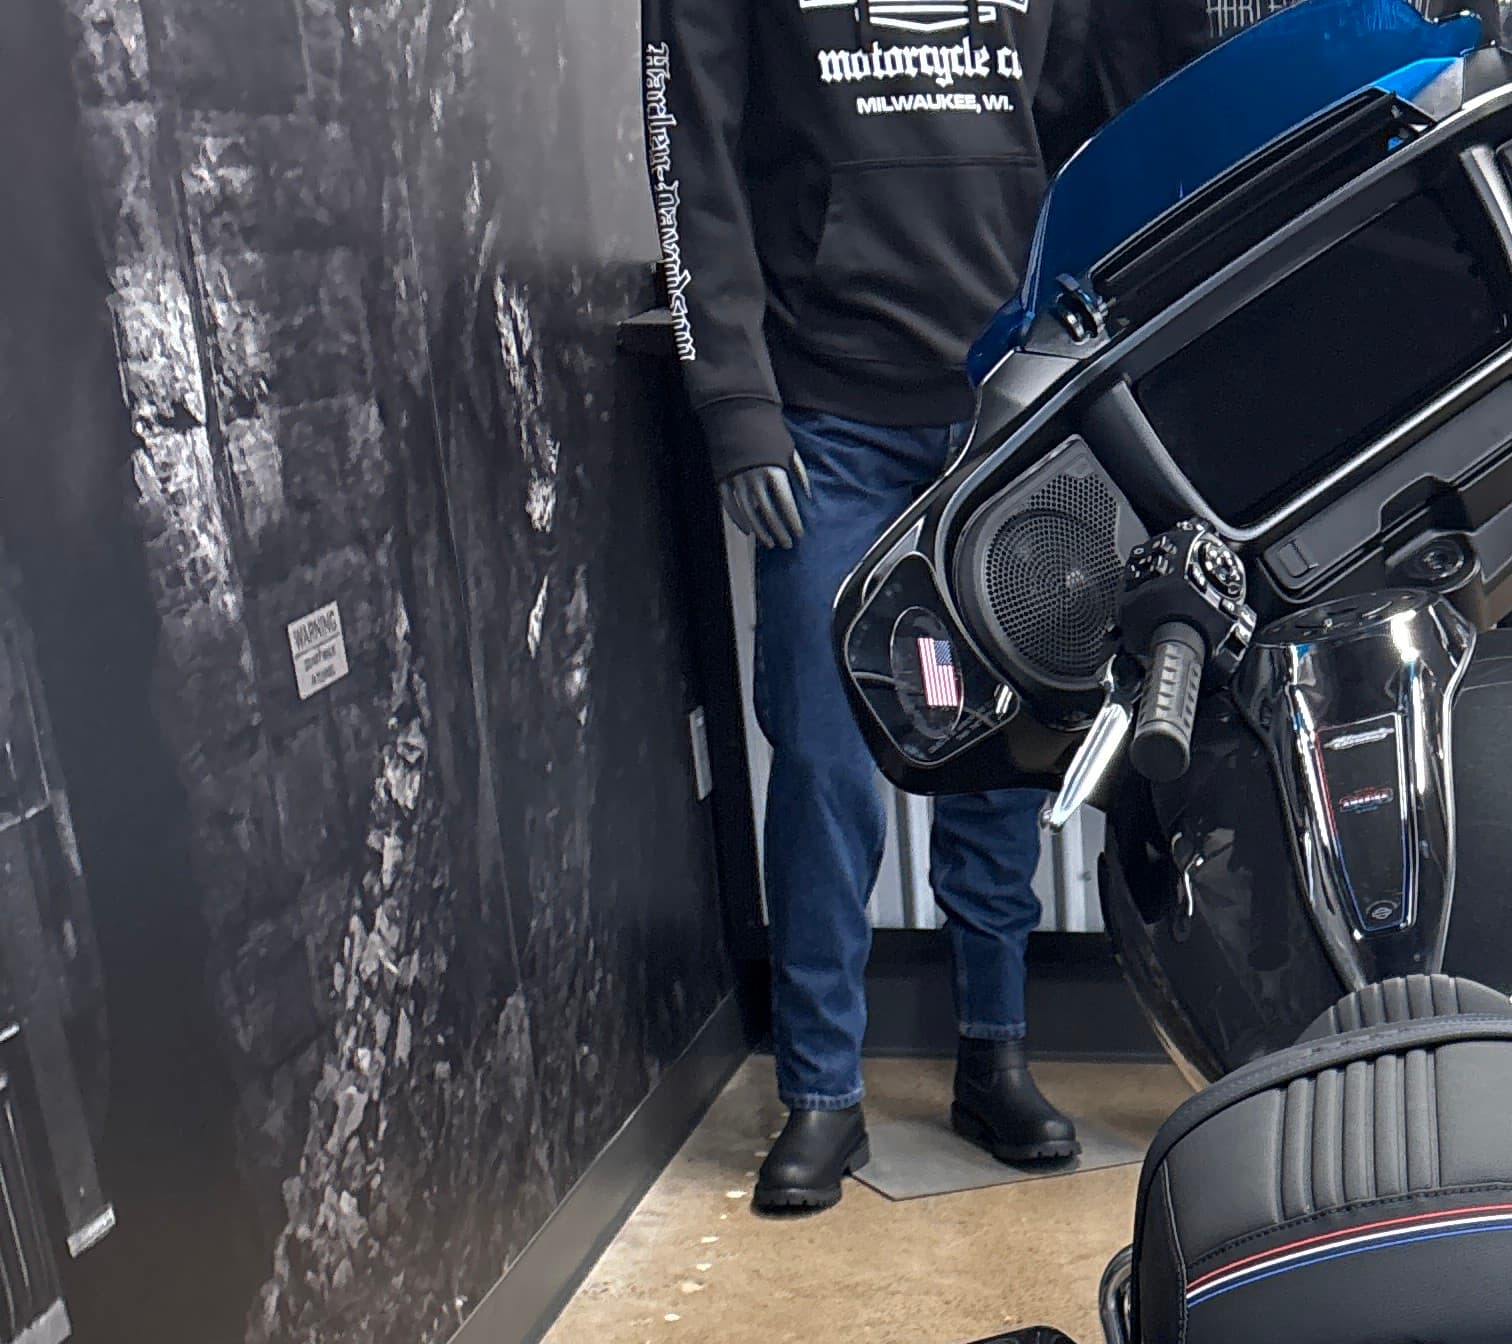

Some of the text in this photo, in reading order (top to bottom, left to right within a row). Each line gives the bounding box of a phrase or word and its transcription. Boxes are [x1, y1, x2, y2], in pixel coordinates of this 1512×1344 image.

[817, 36, 990, 88] motorcycle
[856, 94, 1014, 114] MILWAUKEE, WI.
